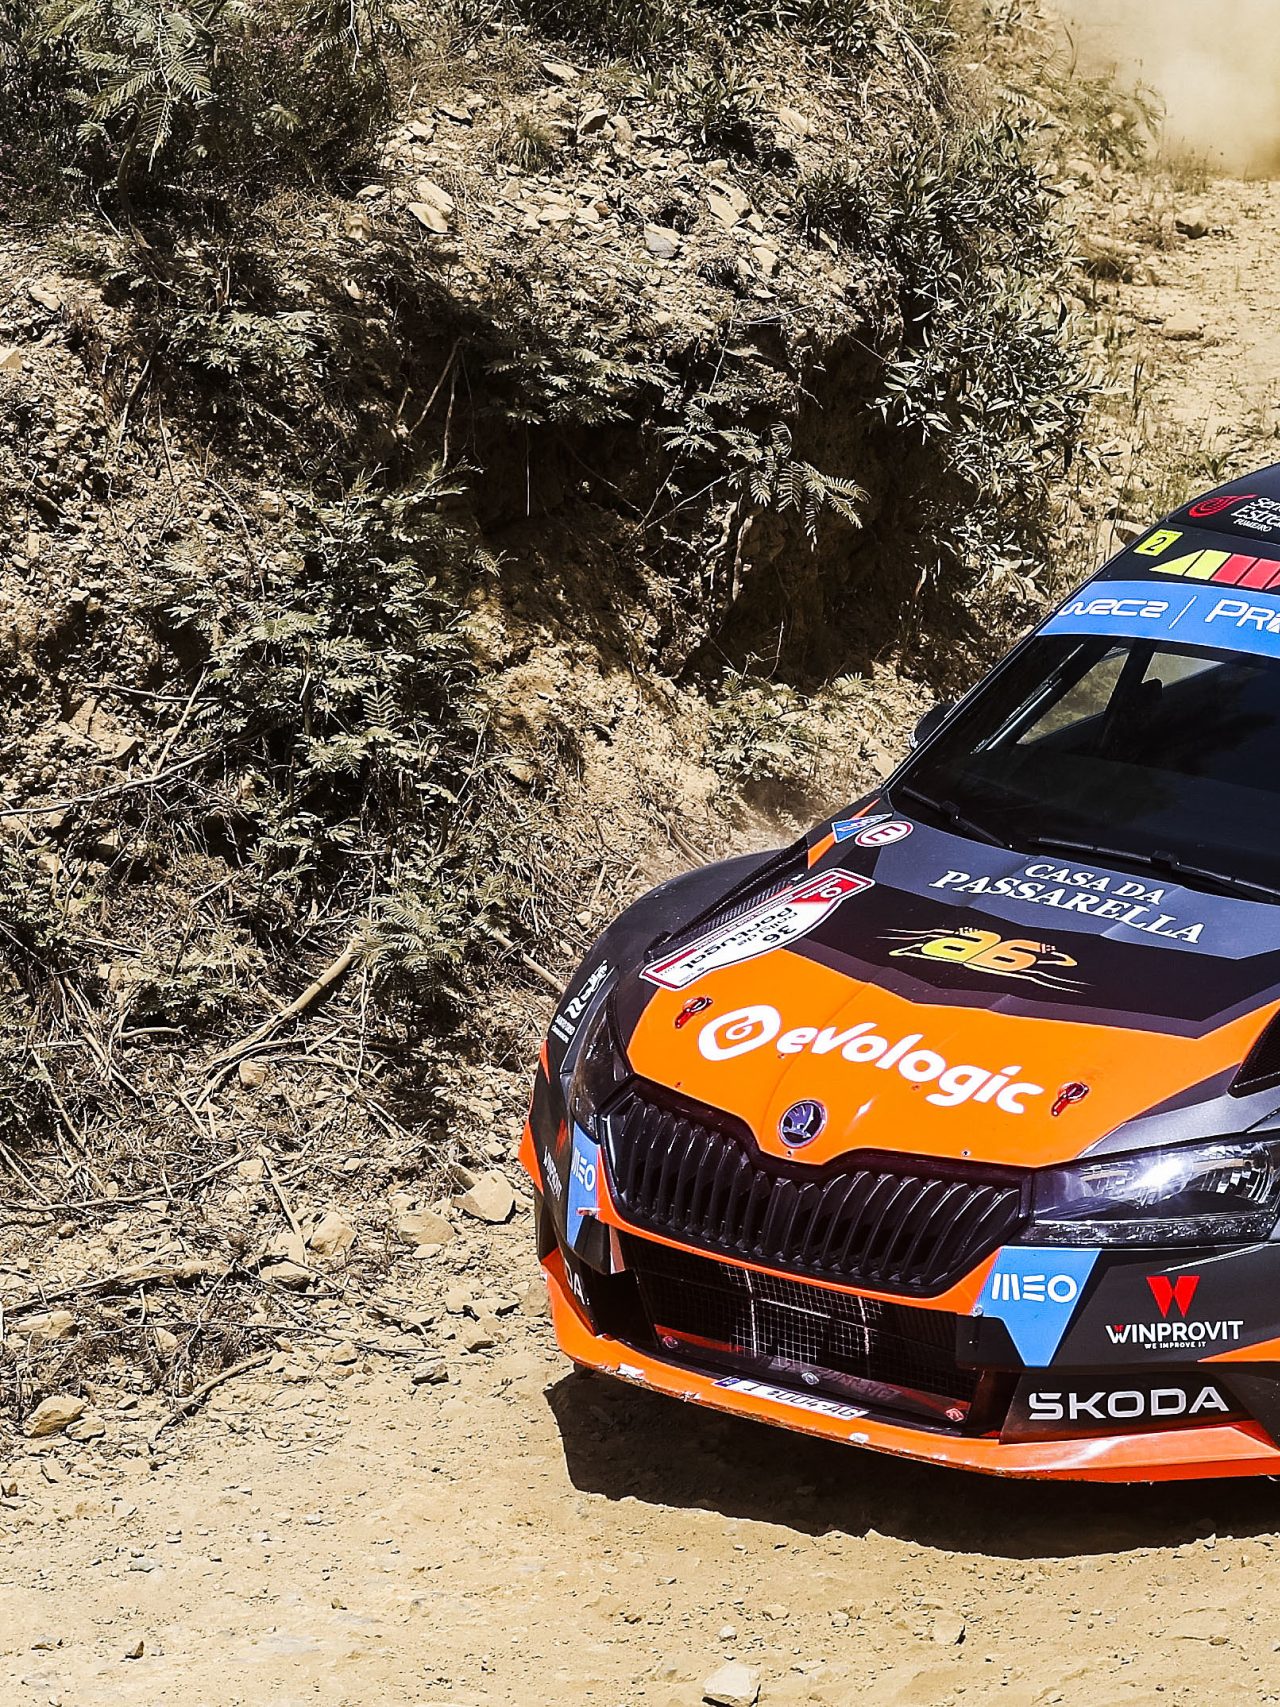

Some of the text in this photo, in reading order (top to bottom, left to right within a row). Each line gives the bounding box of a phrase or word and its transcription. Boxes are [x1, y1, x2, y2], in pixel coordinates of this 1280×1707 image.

[1144, 537, 1167, 551] 2
[1023, 863, 1166, 905] CASA DA
[928, 870, 1206, 943] PASSARELLA
[763, 924, 799, 943] 36
[776, 1022, 1045, 1114] evologic
[991, 1272, 1077, 1303] MEO
[1105, 1320, 1244, 1344] WINPROVIT
[1160, 1341, 1195, 1349] IMPROVE
